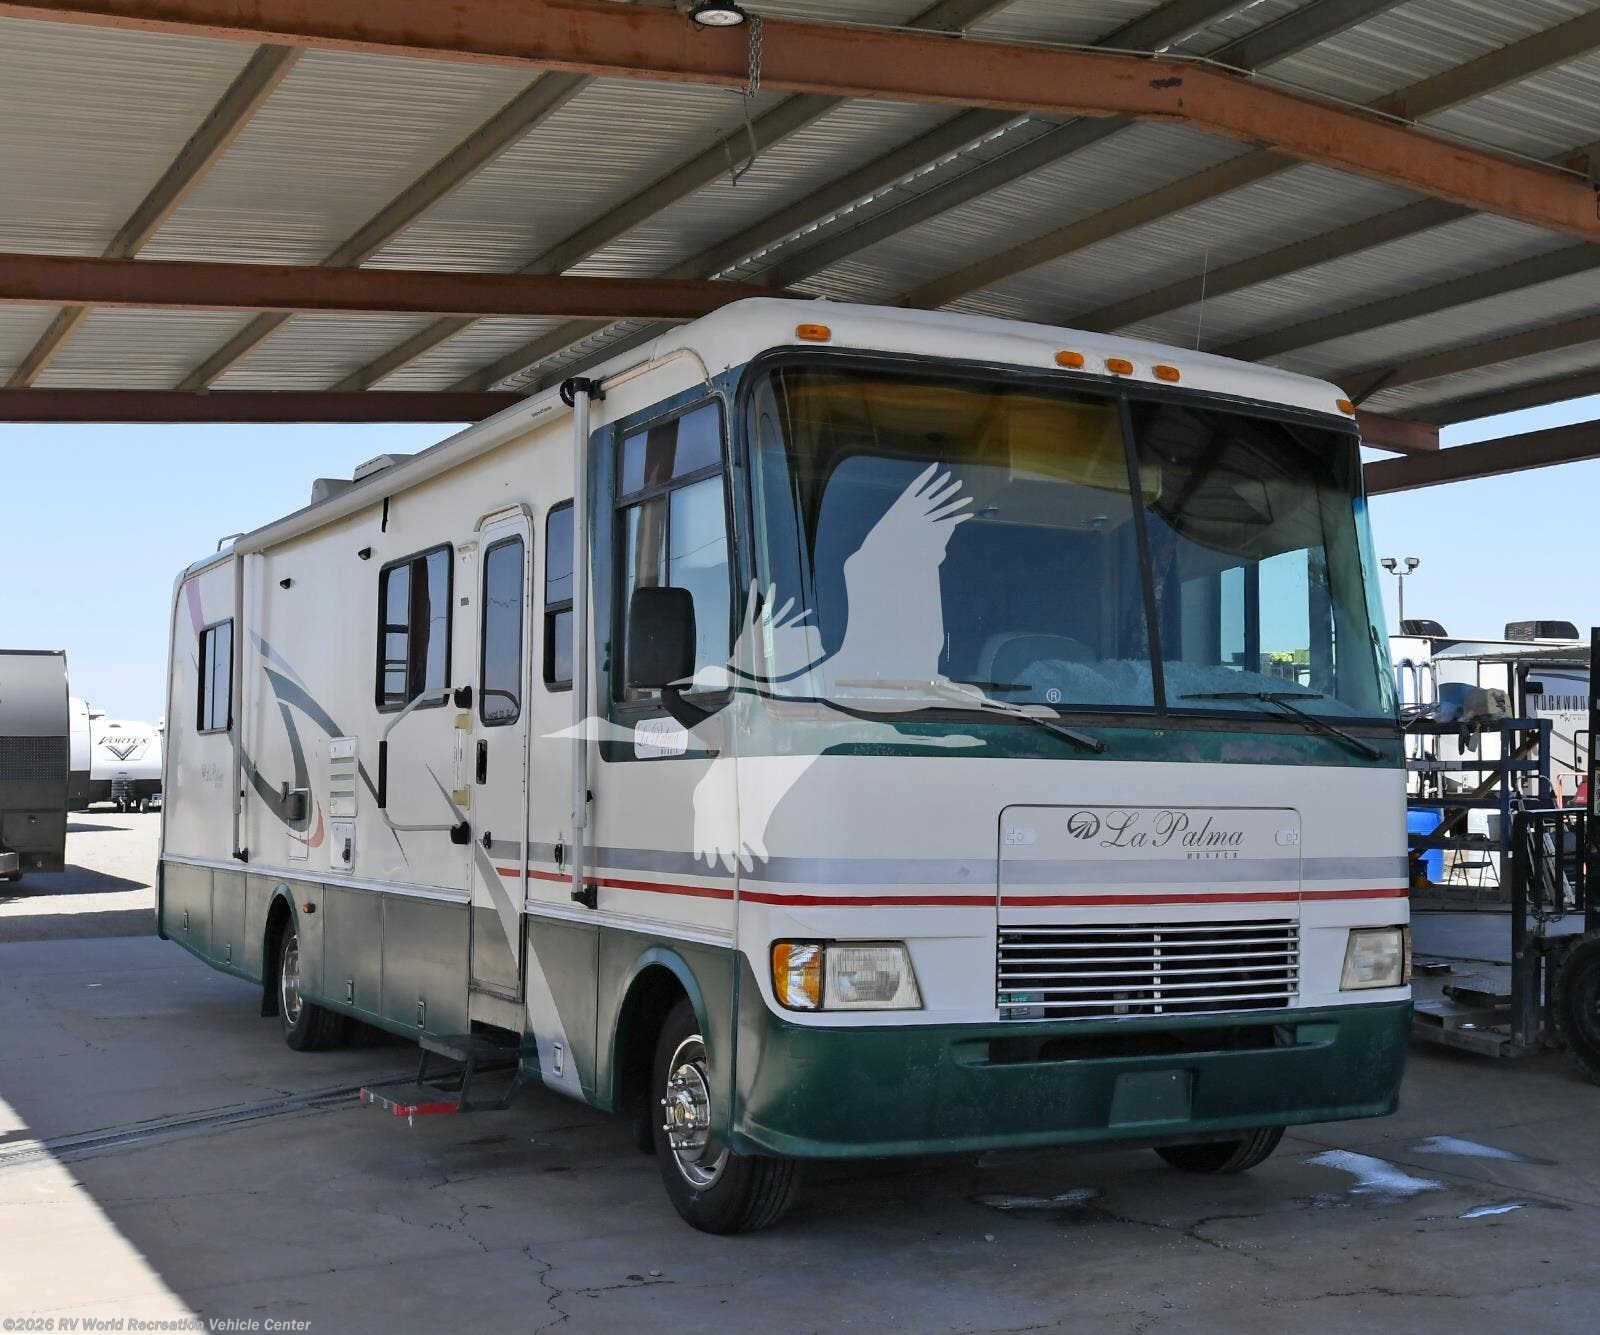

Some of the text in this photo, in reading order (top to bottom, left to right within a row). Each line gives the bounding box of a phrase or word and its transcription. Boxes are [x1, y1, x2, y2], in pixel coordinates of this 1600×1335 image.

[1533, 694, 1590, 711] ROCKWOO
[98, 736, 149, 745] VORTEX
[1100, 810, 1244, 848] La Palma
